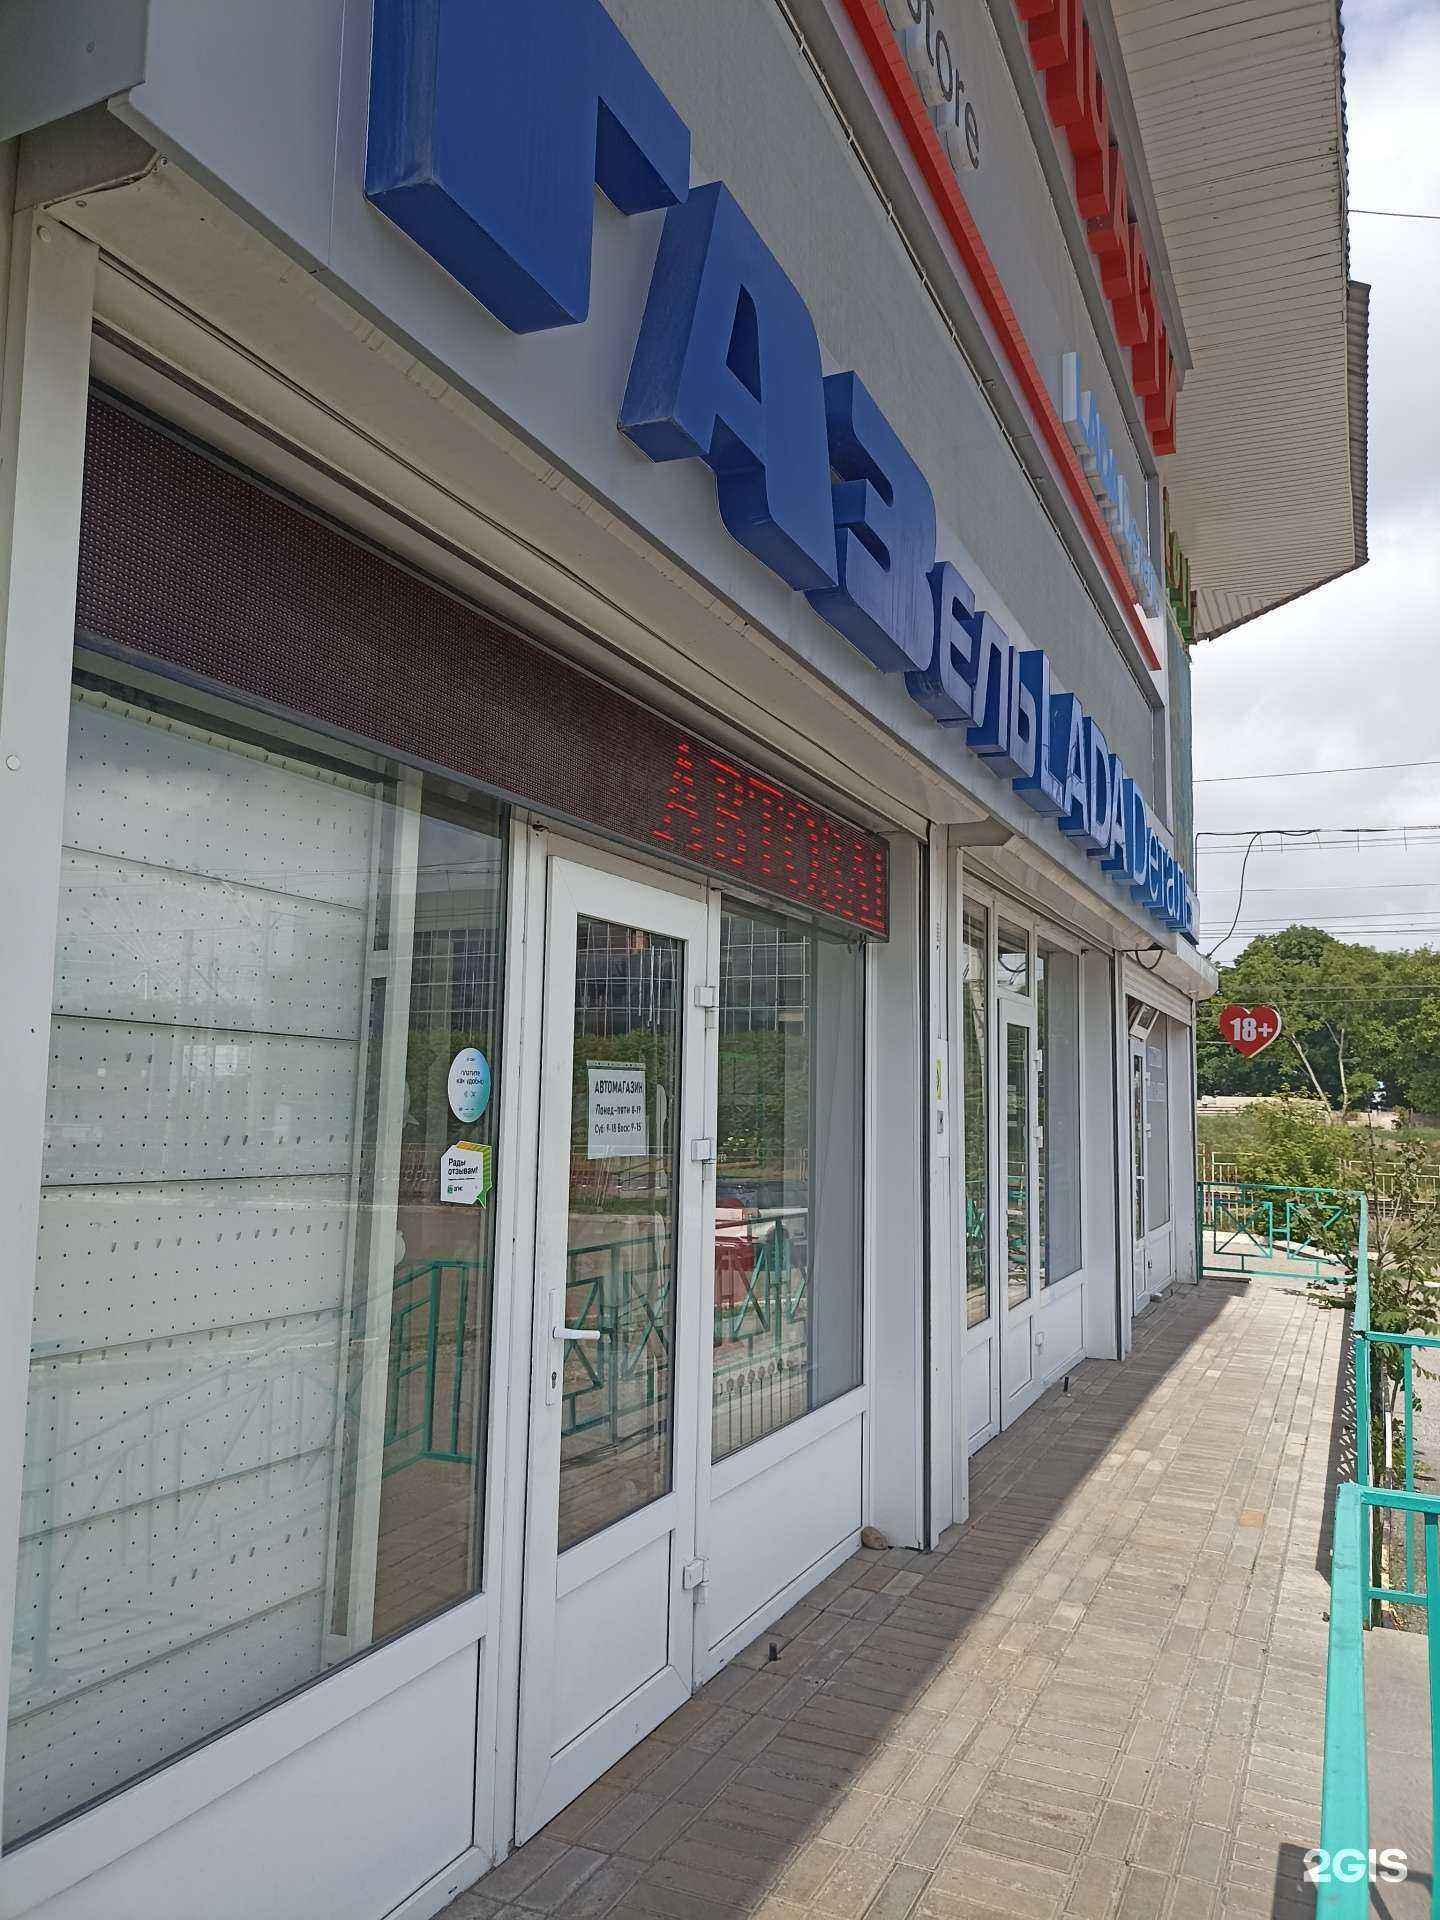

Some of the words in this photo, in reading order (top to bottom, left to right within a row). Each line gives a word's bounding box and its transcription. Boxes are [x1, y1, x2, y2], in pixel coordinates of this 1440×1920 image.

[1229, 1017, 1274, 1042] 18+
[594, 1080, 643, 1095] АВТОМАГАЗИН
[448, 1157, 466, 1168] Рады
[447, 1166, 479, 1176] отзывам!
